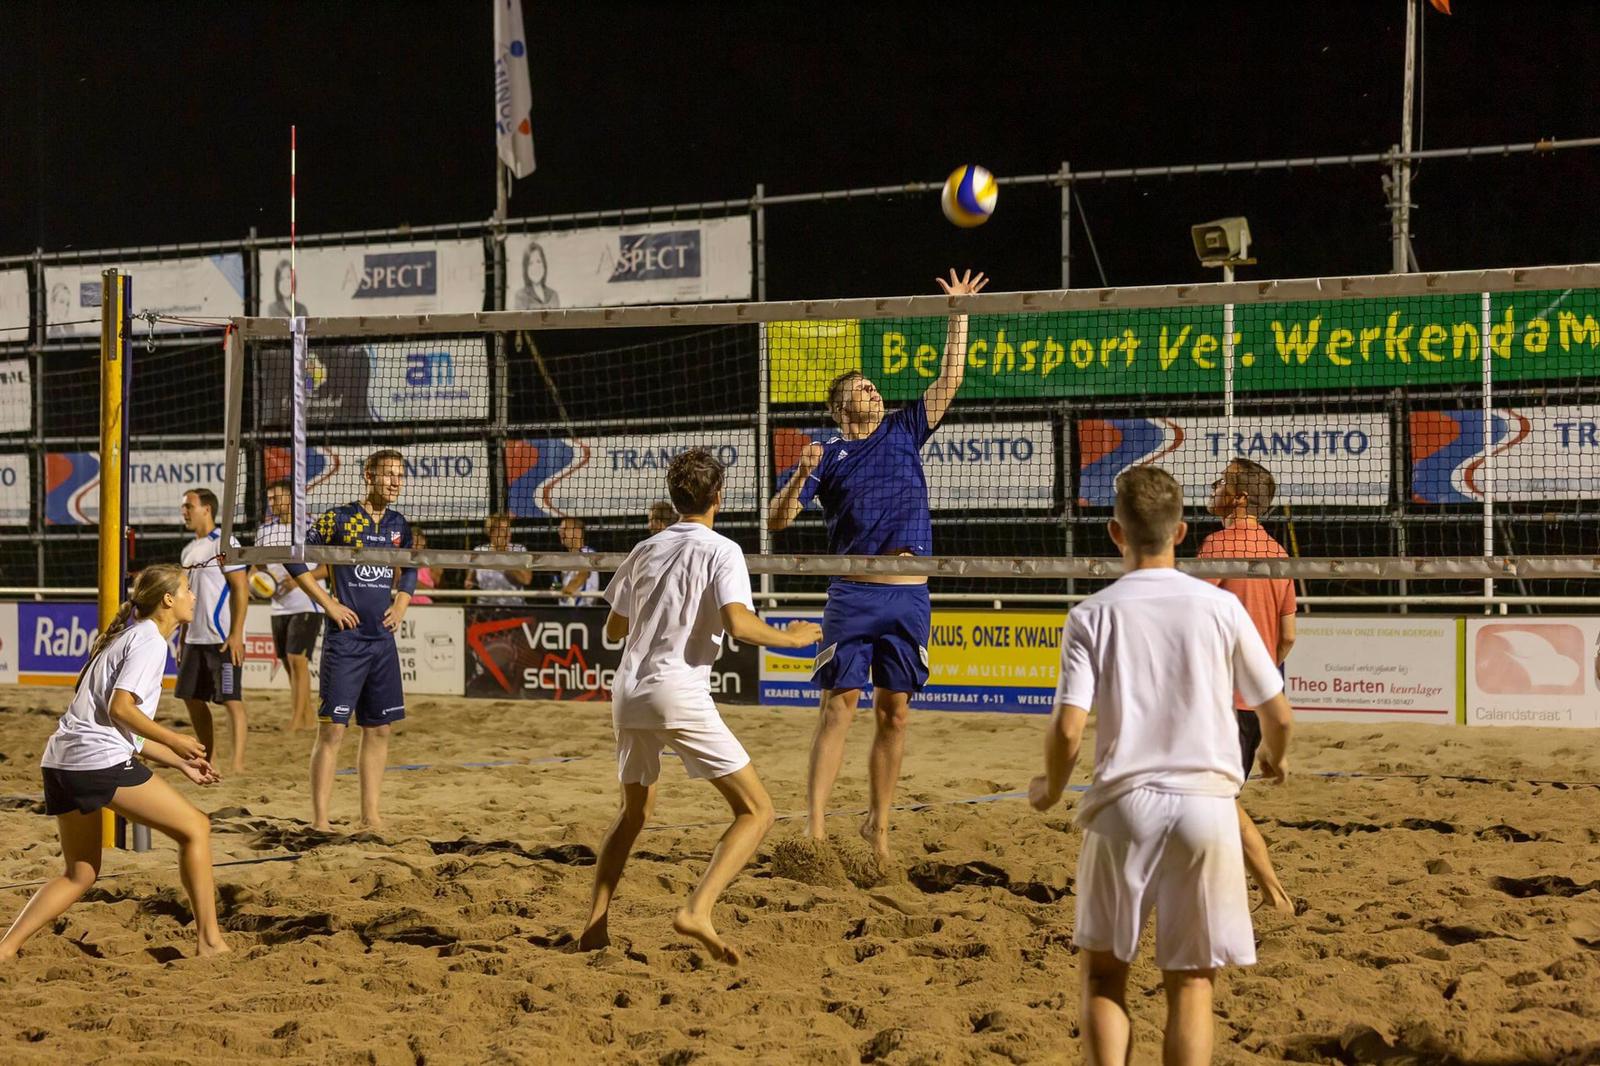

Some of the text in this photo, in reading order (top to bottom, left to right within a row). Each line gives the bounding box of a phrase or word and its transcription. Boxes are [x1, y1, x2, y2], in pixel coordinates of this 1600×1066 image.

[882, 328, 1140, 378] Bechsport
[608, 444, 737, 470] TRANO
[921, 437, 1033, 463] ANSITO
[522, 622, 589, 651] van
[931, 625, 967, 650] KLUS,
[972, 625, 1010, 647] ONZE
[931, 664, 1056, 678] WW.MULTIMATE
[801, 689, 821, 698] WER
[911, 692, 979, 703] INGHSTRAAT
[982, 693, 1004, 704] 9-11
[1288, 676, 1442, 697] Theo Barten keurslager
[1475, 706, 1573, 721] Calandstraat 1
